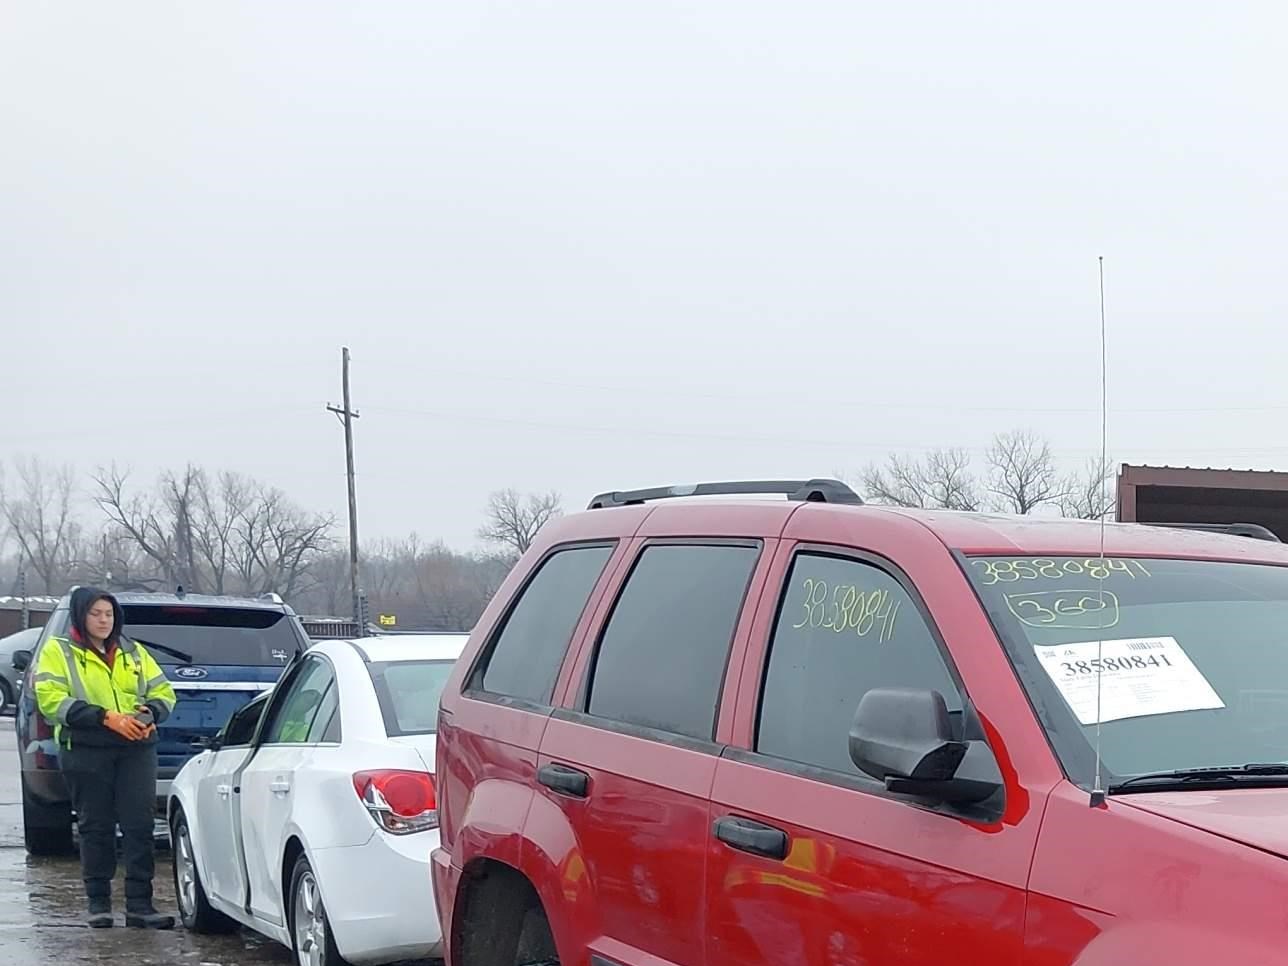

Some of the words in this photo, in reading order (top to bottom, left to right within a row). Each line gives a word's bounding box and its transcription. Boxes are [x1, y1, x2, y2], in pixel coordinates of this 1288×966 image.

[971, 557, 1151, 585] 38580841
[794, 578, 900, 643] 38580841
[1061, 654, 1174, 677] 38580841
